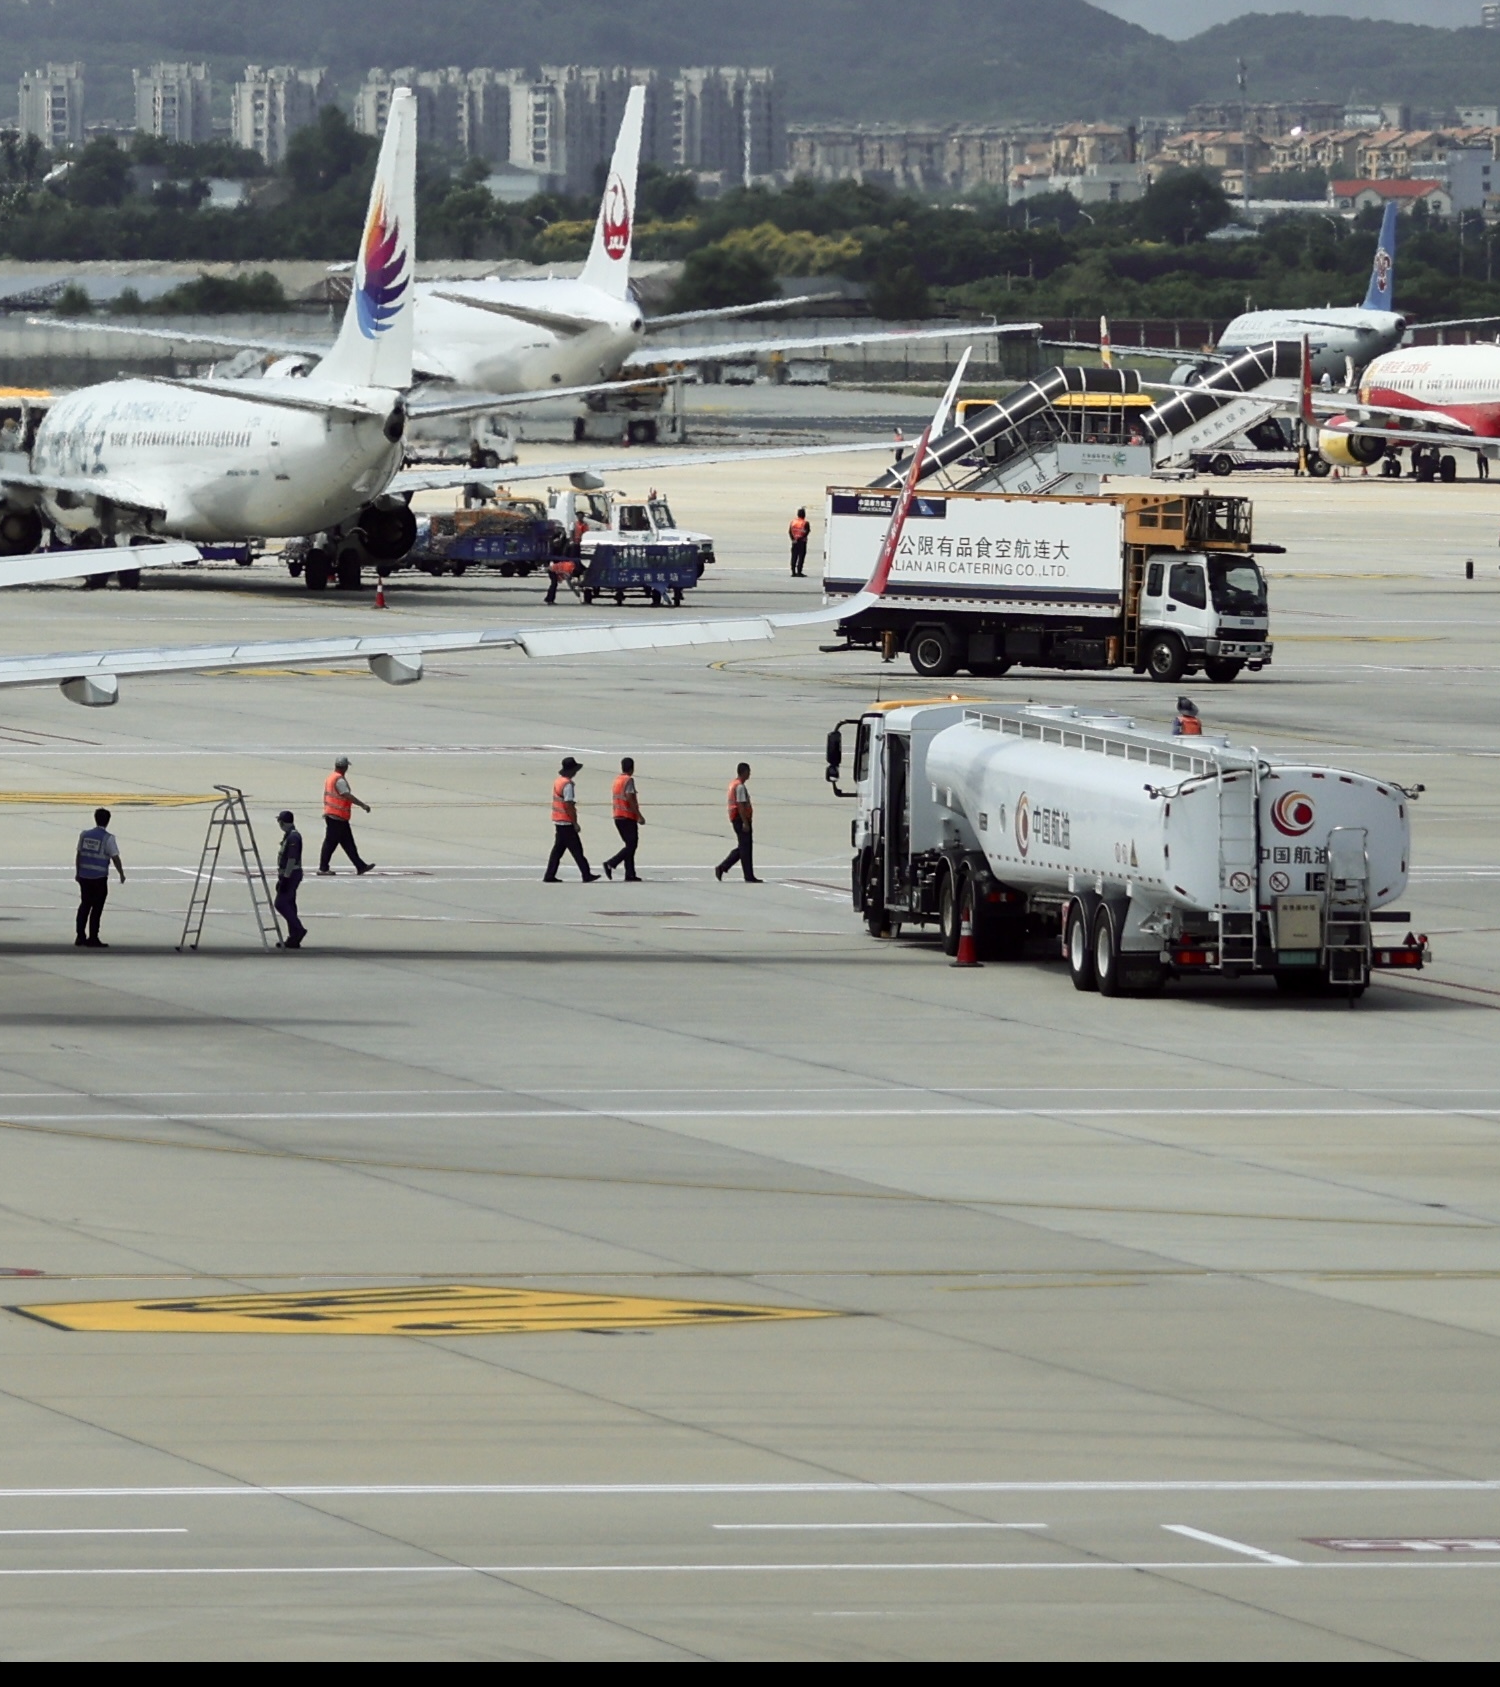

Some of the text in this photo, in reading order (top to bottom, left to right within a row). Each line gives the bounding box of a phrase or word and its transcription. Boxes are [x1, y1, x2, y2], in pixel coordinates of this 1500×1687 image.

[925, 562, 946, 574] AIR
[948, 563, 1013, 576] CATERING
[1033, 805, 1070, 850] 中国航油
